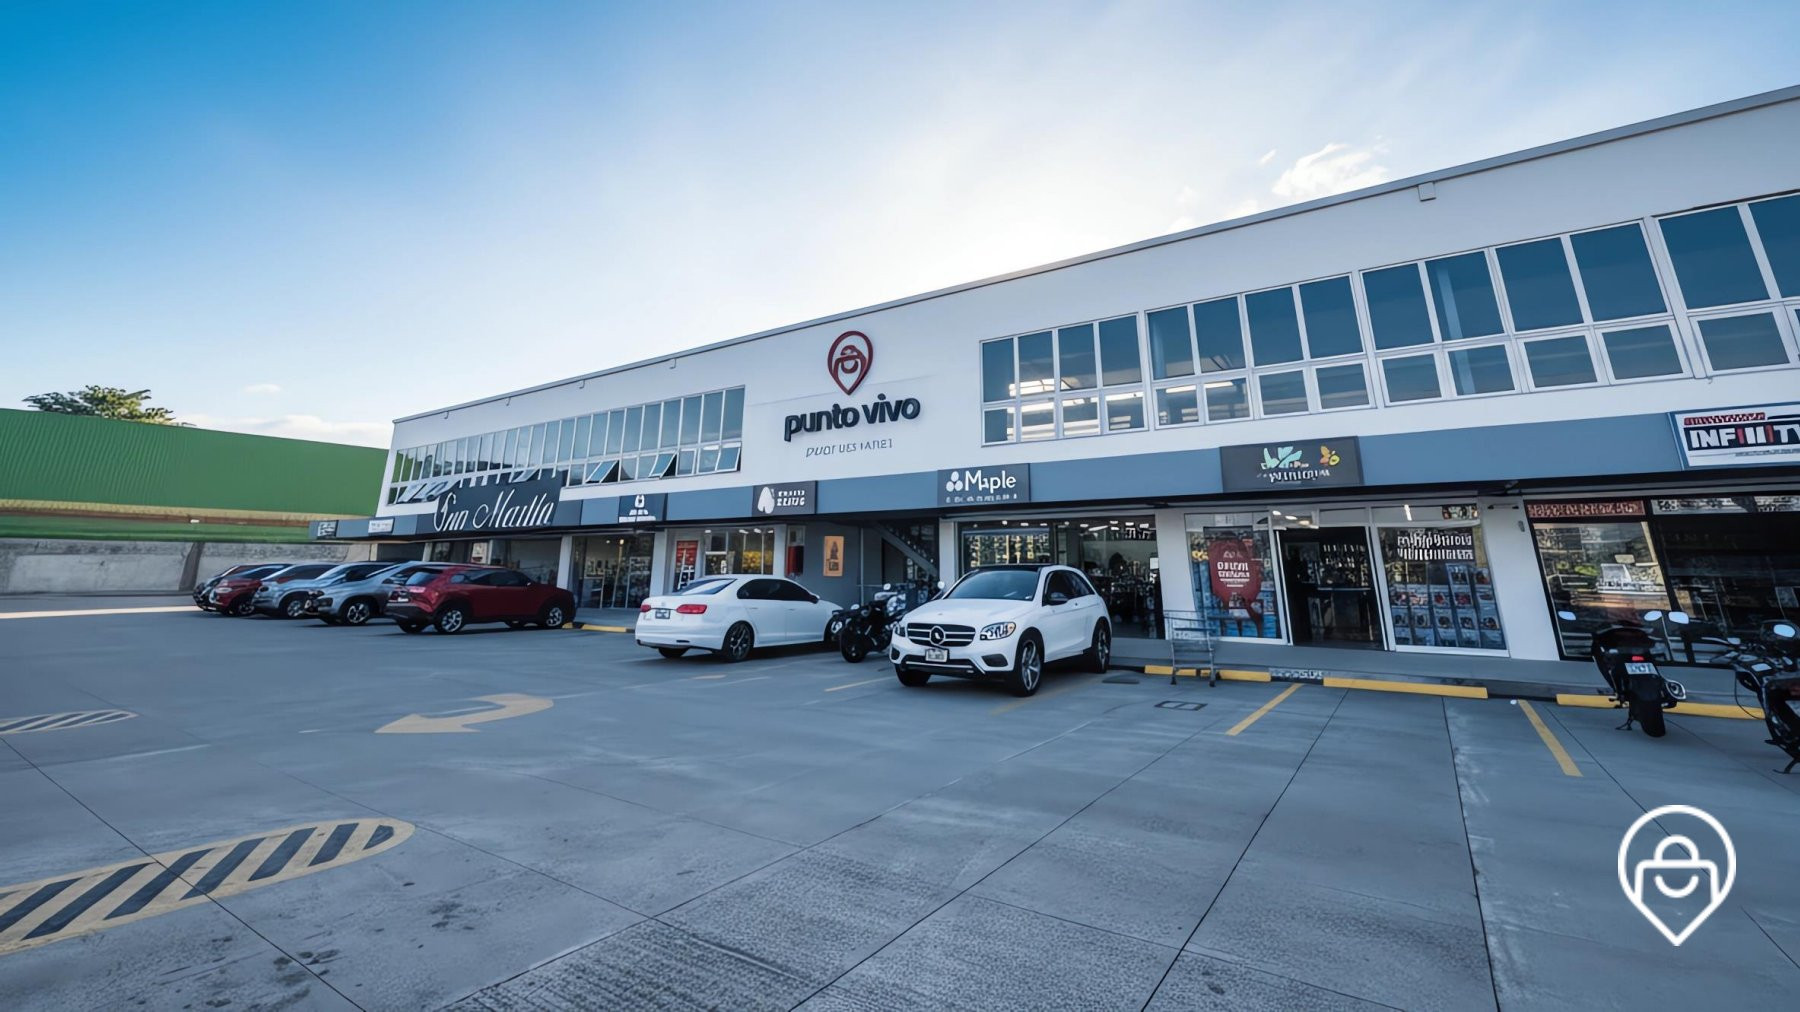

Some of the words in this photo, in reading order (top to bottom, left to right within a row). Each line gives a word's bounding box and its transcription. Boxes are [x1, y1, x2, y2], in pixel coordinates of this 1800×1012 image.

[784, 403, 859, 442] punto
[861, 393, 921, 424] vivo
[965, 470, 1017, 493] Maple
